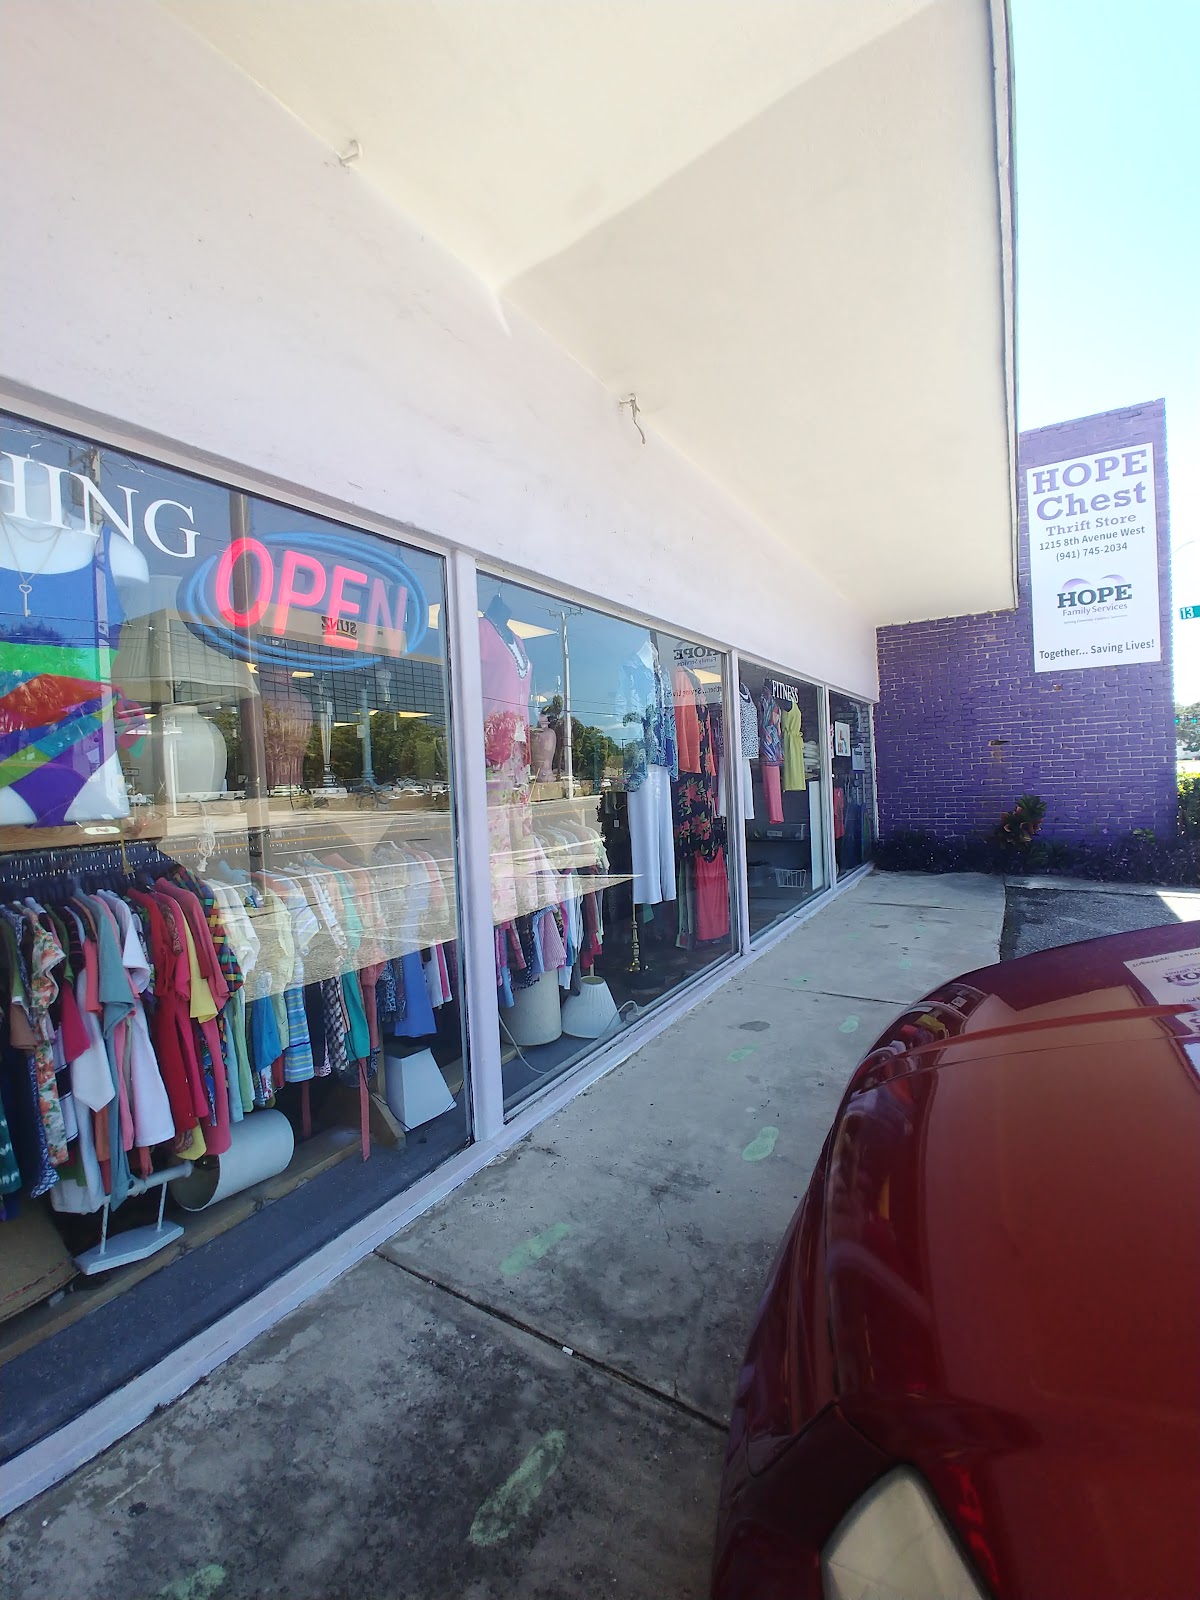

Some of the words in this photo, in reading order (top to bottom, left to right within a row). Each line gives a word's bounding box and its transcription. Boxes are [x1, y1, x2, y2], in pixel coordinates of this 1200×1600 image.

[1032, 449, 1148, 495] HOPE
[0, 452, 200, 558] HING
[1036, 480, 1147, 521] Chest
[1039, 539, 1062, 551] 1215
[1063, 536, 1080, 547] 8th
[1081, 531, 1118, 544] Avenue
[1120, 525, 1146, 537] West
[1045, 520, 1091, 537] Thrift
[1095, 514, 1137, 529] Store
[1056, 549, 1081, 563] (941)
[1083, 541, 1128, 557] 745-2034
[215, 536, 408, 658] OPEN
[1057, 583, 1133, 609] HOPE
[1062, 607, 1091, 617] Family
[1092, 603, 1128, 613] Services
[1039, 648, 1089, 661] Together...
[1090, 643, 1124, 654] Saving
[1125, 639, 1155, 651] Lives!
[772, 680, 799, 703] FITNESS
